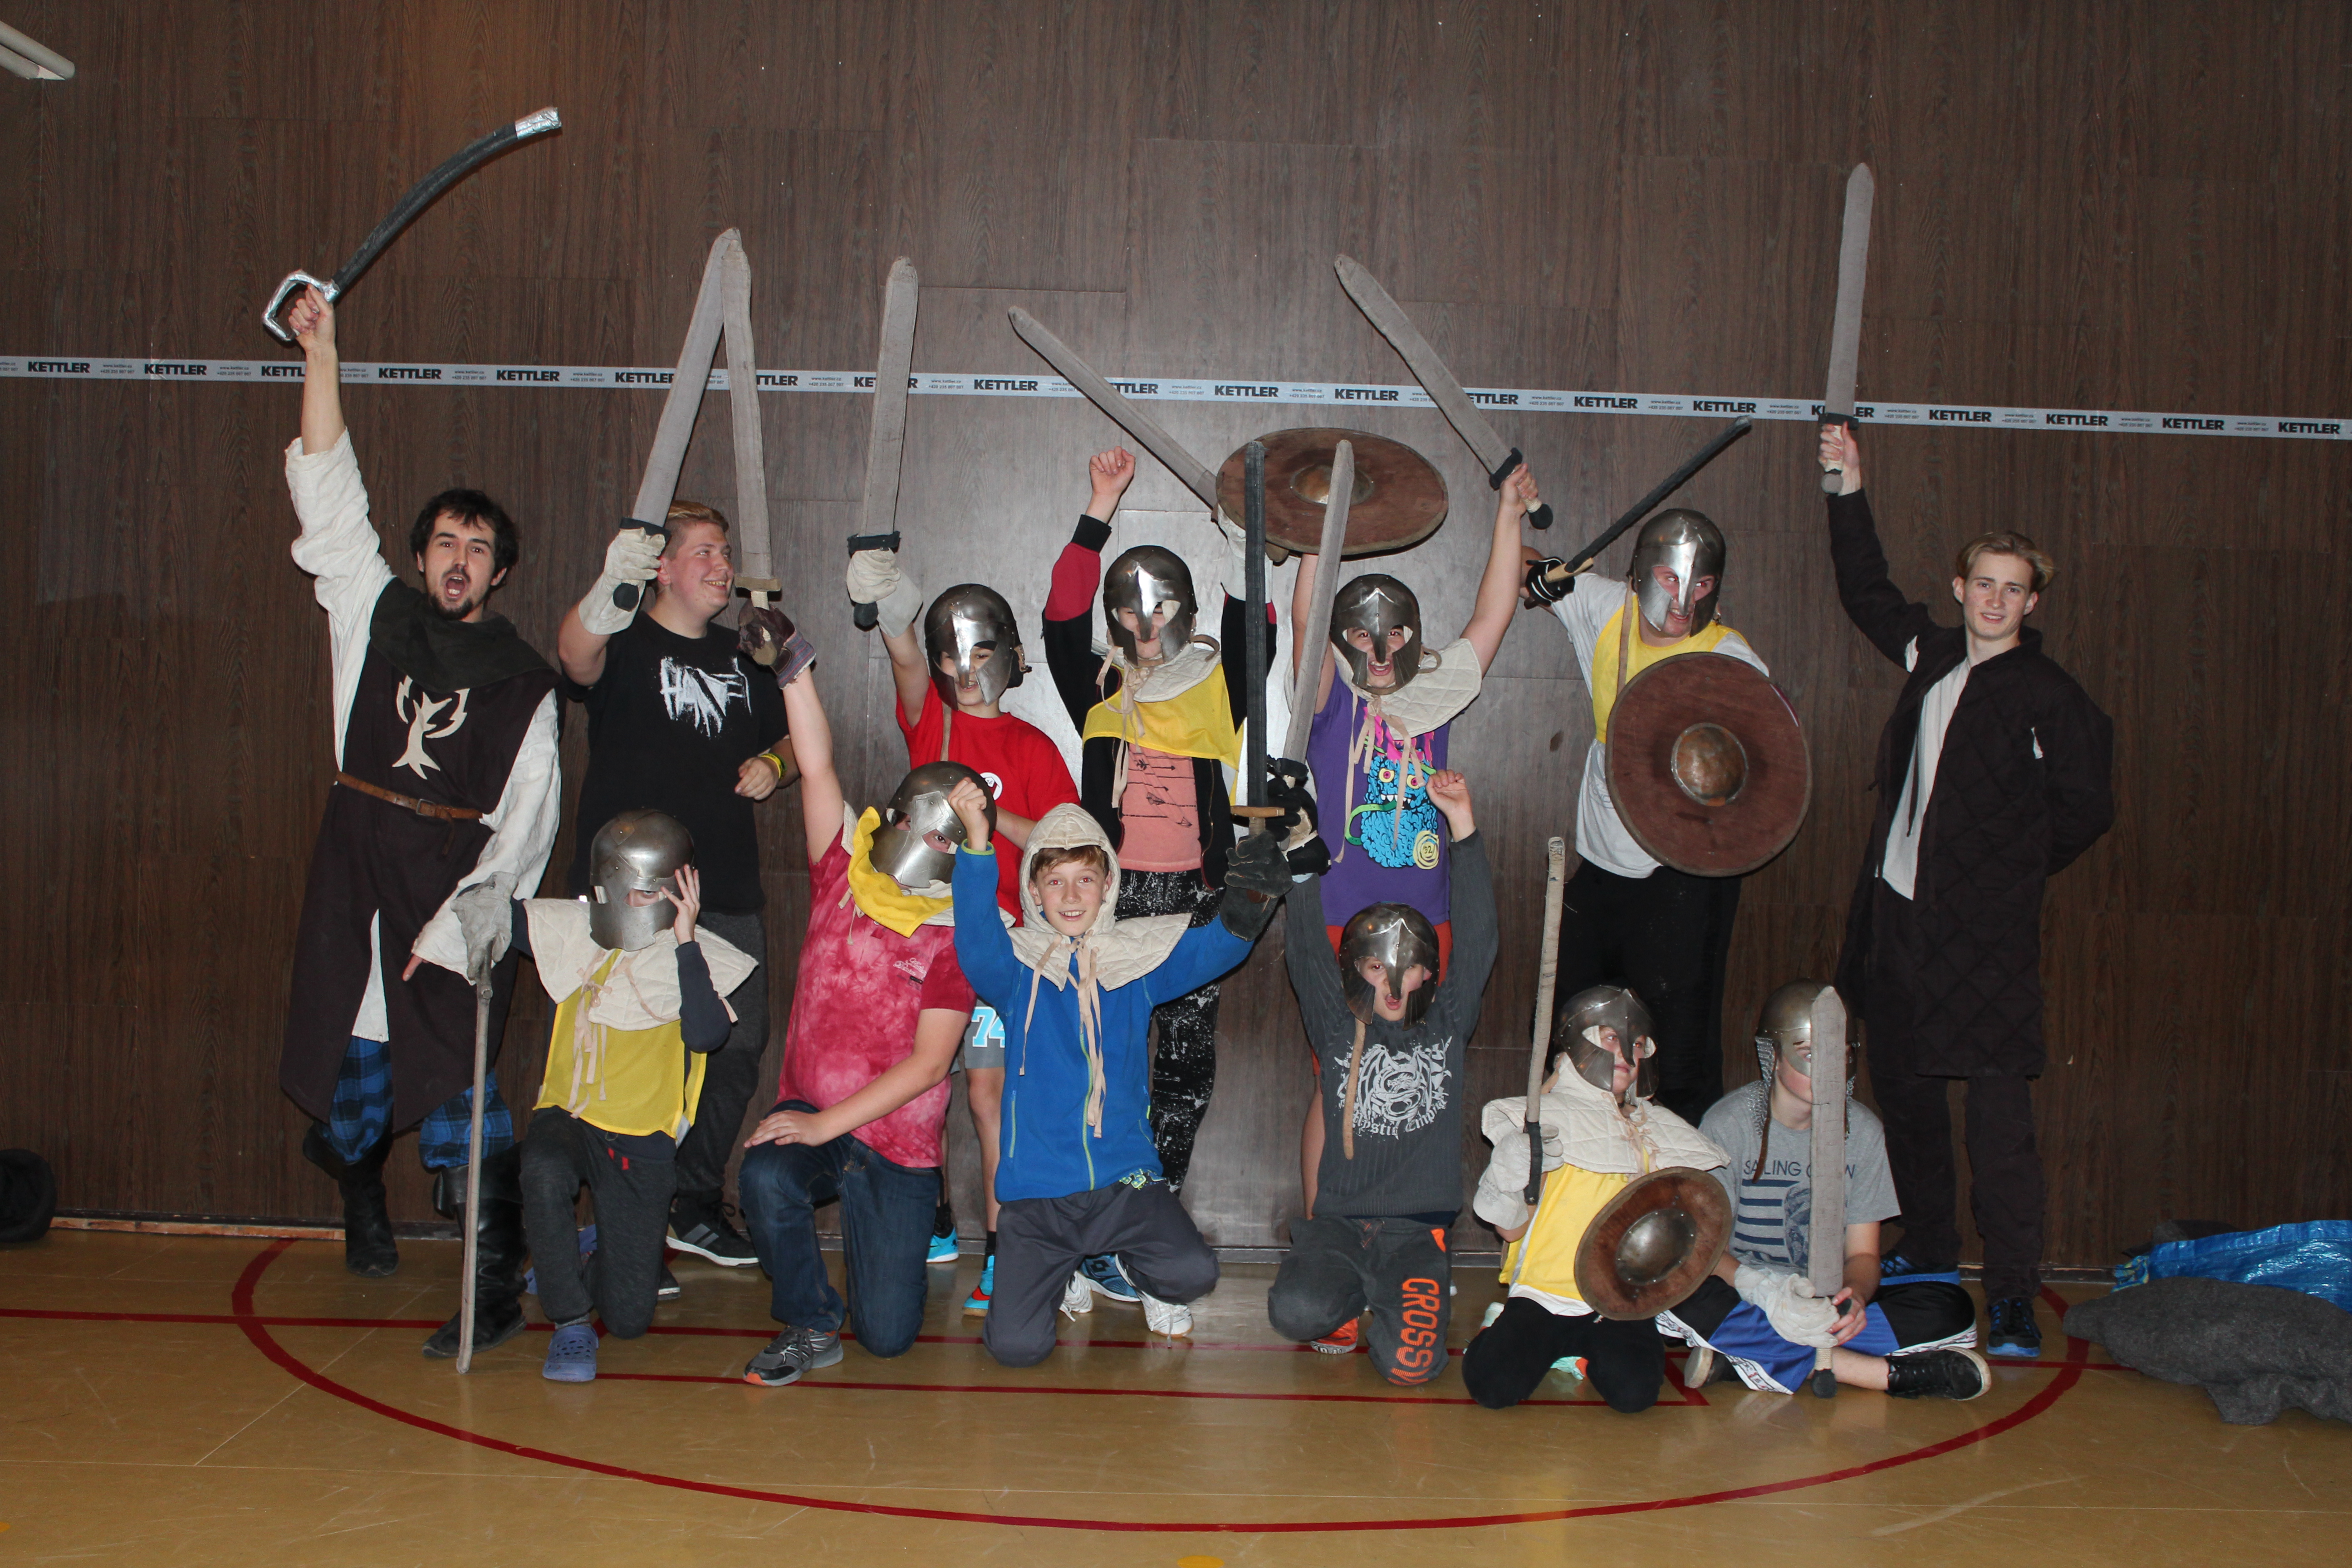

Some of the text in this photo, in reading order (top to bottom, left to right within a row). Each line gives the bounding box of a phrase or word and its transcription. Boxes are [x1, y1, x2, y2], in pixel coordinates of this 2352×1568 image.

[28, 362, 90, 373] KETTLER
[145, 363, 206, 375] KETTLER
[262, 366, 304, 377] KETTL
[379, 368, 441, 379] KETTLER
[497, 370, 559, 381] KETTLER
[756, 375, 798, 386] TTLER
[974, 379, 1038, 391] KETTLER
[1110, 383, 1158, 394] TTLER
[1215, 385, 1278, 397] KETTLER
[1335, 389, 1398, 401] KETTLER
[1466, 393, 1518, 404] ETTLER
[1574, 397, 1637, 409] KETTLER
[1694, 401, 1756, 413] KETTLER
[1929, 410, 1991, 421] KETTLER
[2046, 414, 2108, 426] KETTLER
[2163, 418, 2224, 431] KETTLER
[2278, 422, 2340, 434] KETTLER
[971, 1006, 1005, 1048] 74
[1744, 1160, 1802, 1176] SALING
